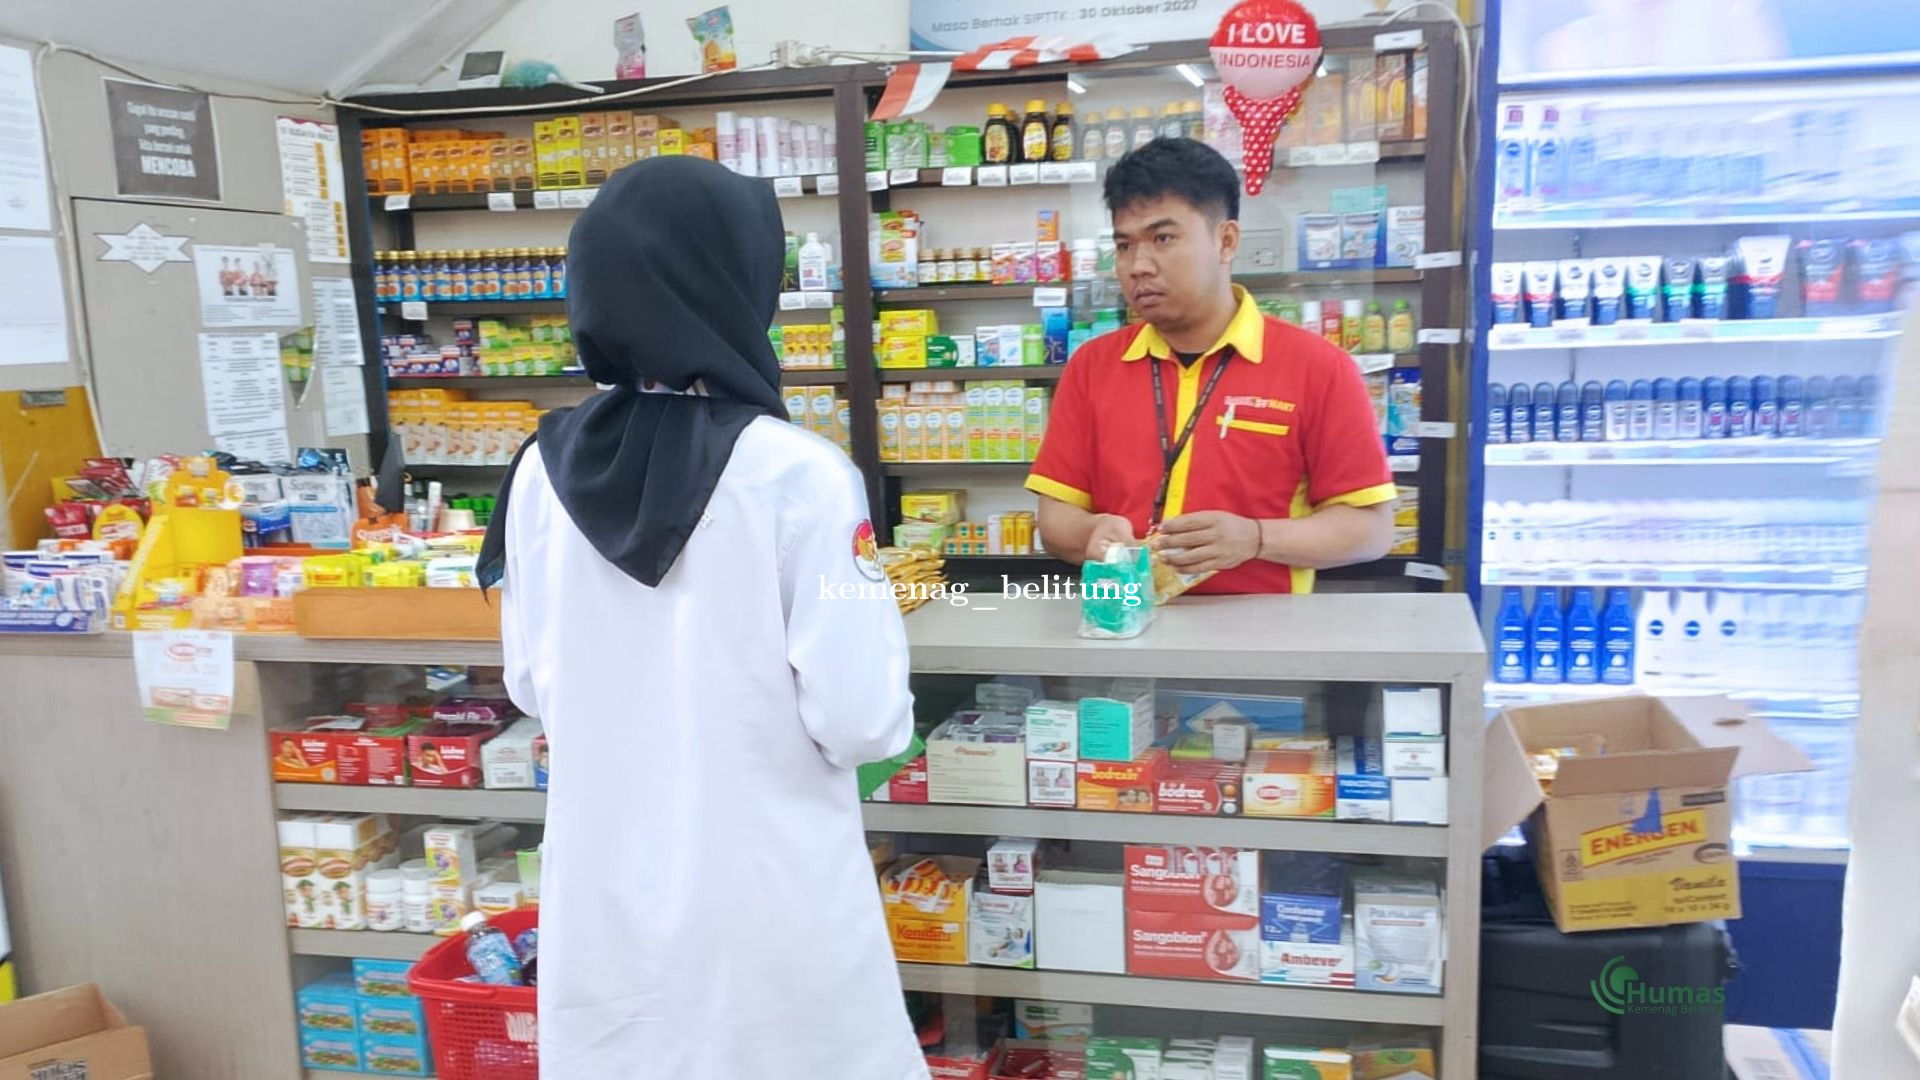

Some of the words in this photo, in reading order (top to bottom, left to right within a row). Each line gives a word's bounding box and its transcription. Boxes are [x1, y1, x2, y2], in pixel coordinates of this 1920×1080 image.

[931, 21, 969, 32] Masa
[972, 14, 1020, 29] Berhak
[1100, 4, 1161, 17] Oktober
[1163, 0, 1199, 12] 2027
[1227, 23, 1237, 44] I
[1240, 21, 1307, 44] LOVE
[1220, 53, 1311, 68] INDONESIA
[1132, 929, 1205, 945] Sangobion
